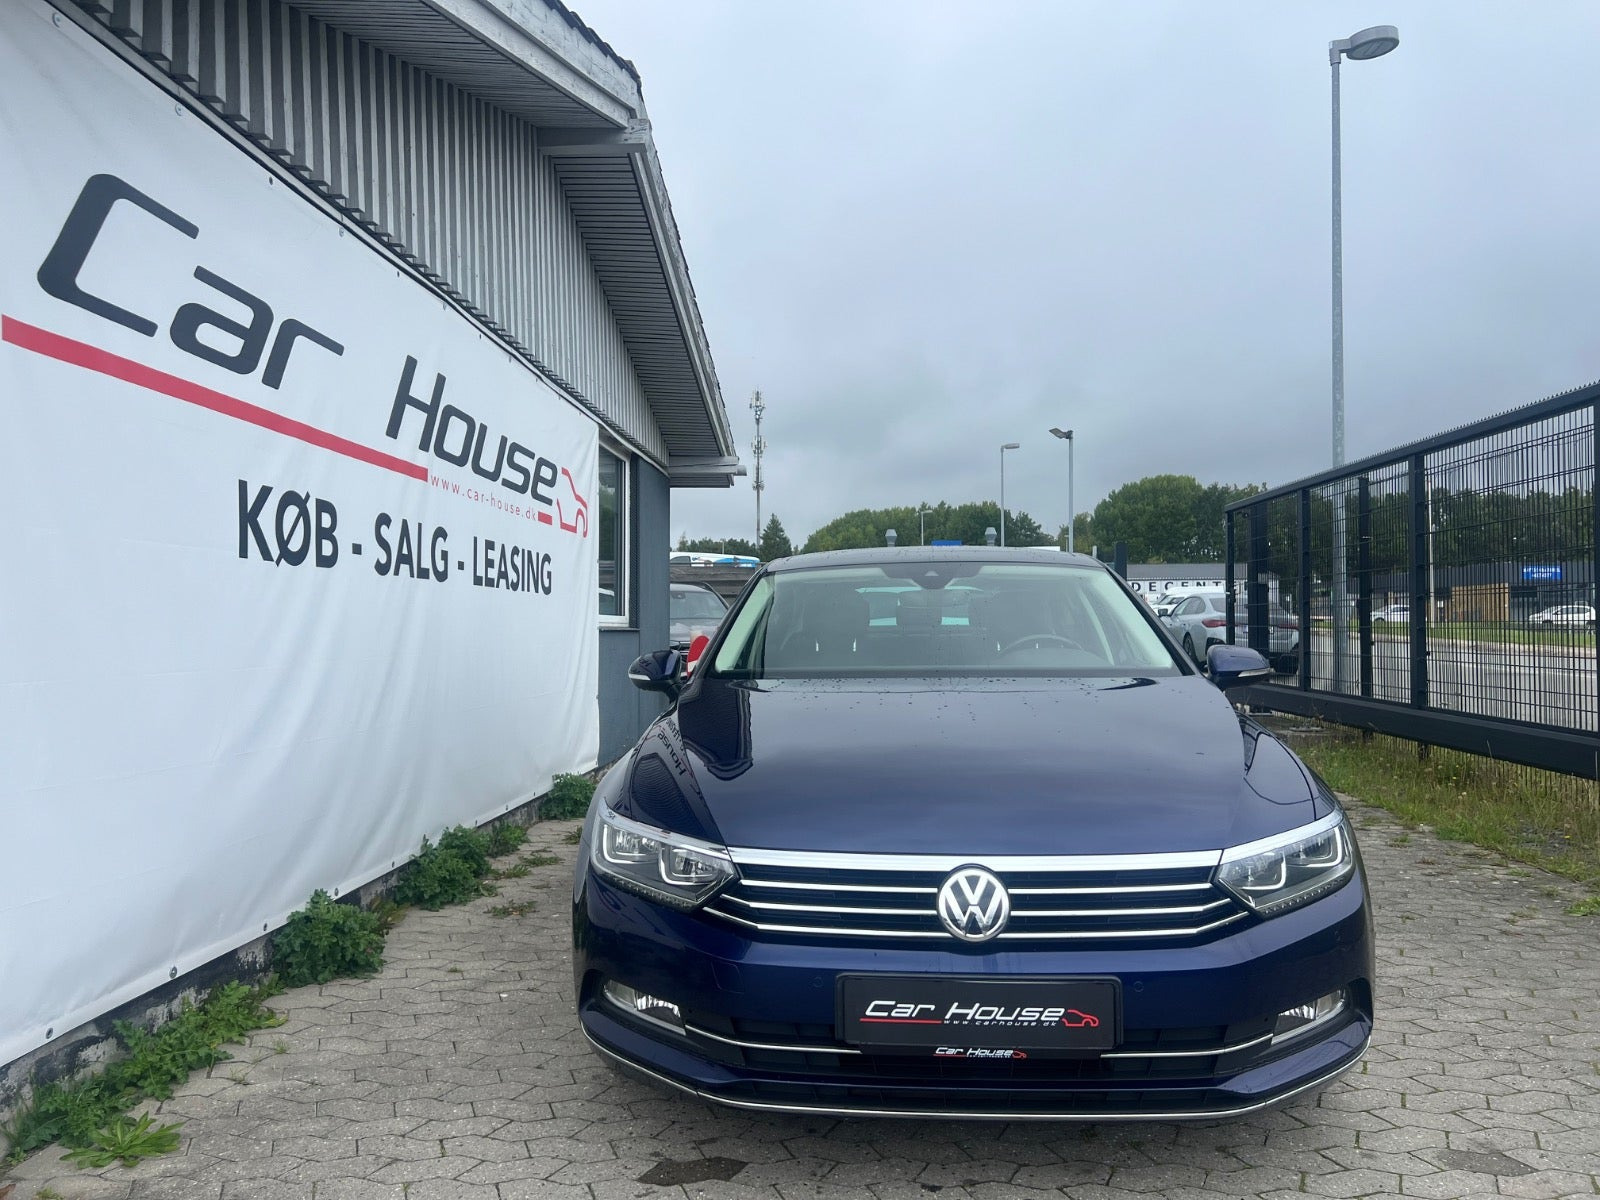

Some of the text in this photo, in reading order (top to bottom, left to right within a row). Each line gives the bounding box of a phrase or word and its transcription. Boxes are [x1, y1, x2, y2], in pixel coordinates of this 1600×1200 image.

[37, 173, 558, 507] Car House
[430, 475, 537, 520] www.car-house.dk
[238, 479, 339, 569] KØB
[374, 512, 449, 583] SALG
[473, 536, 552, 596] LEASING
[865, 1000, 1066, 1021] Car House
[935, 1046, 1014, 1056] Car House
